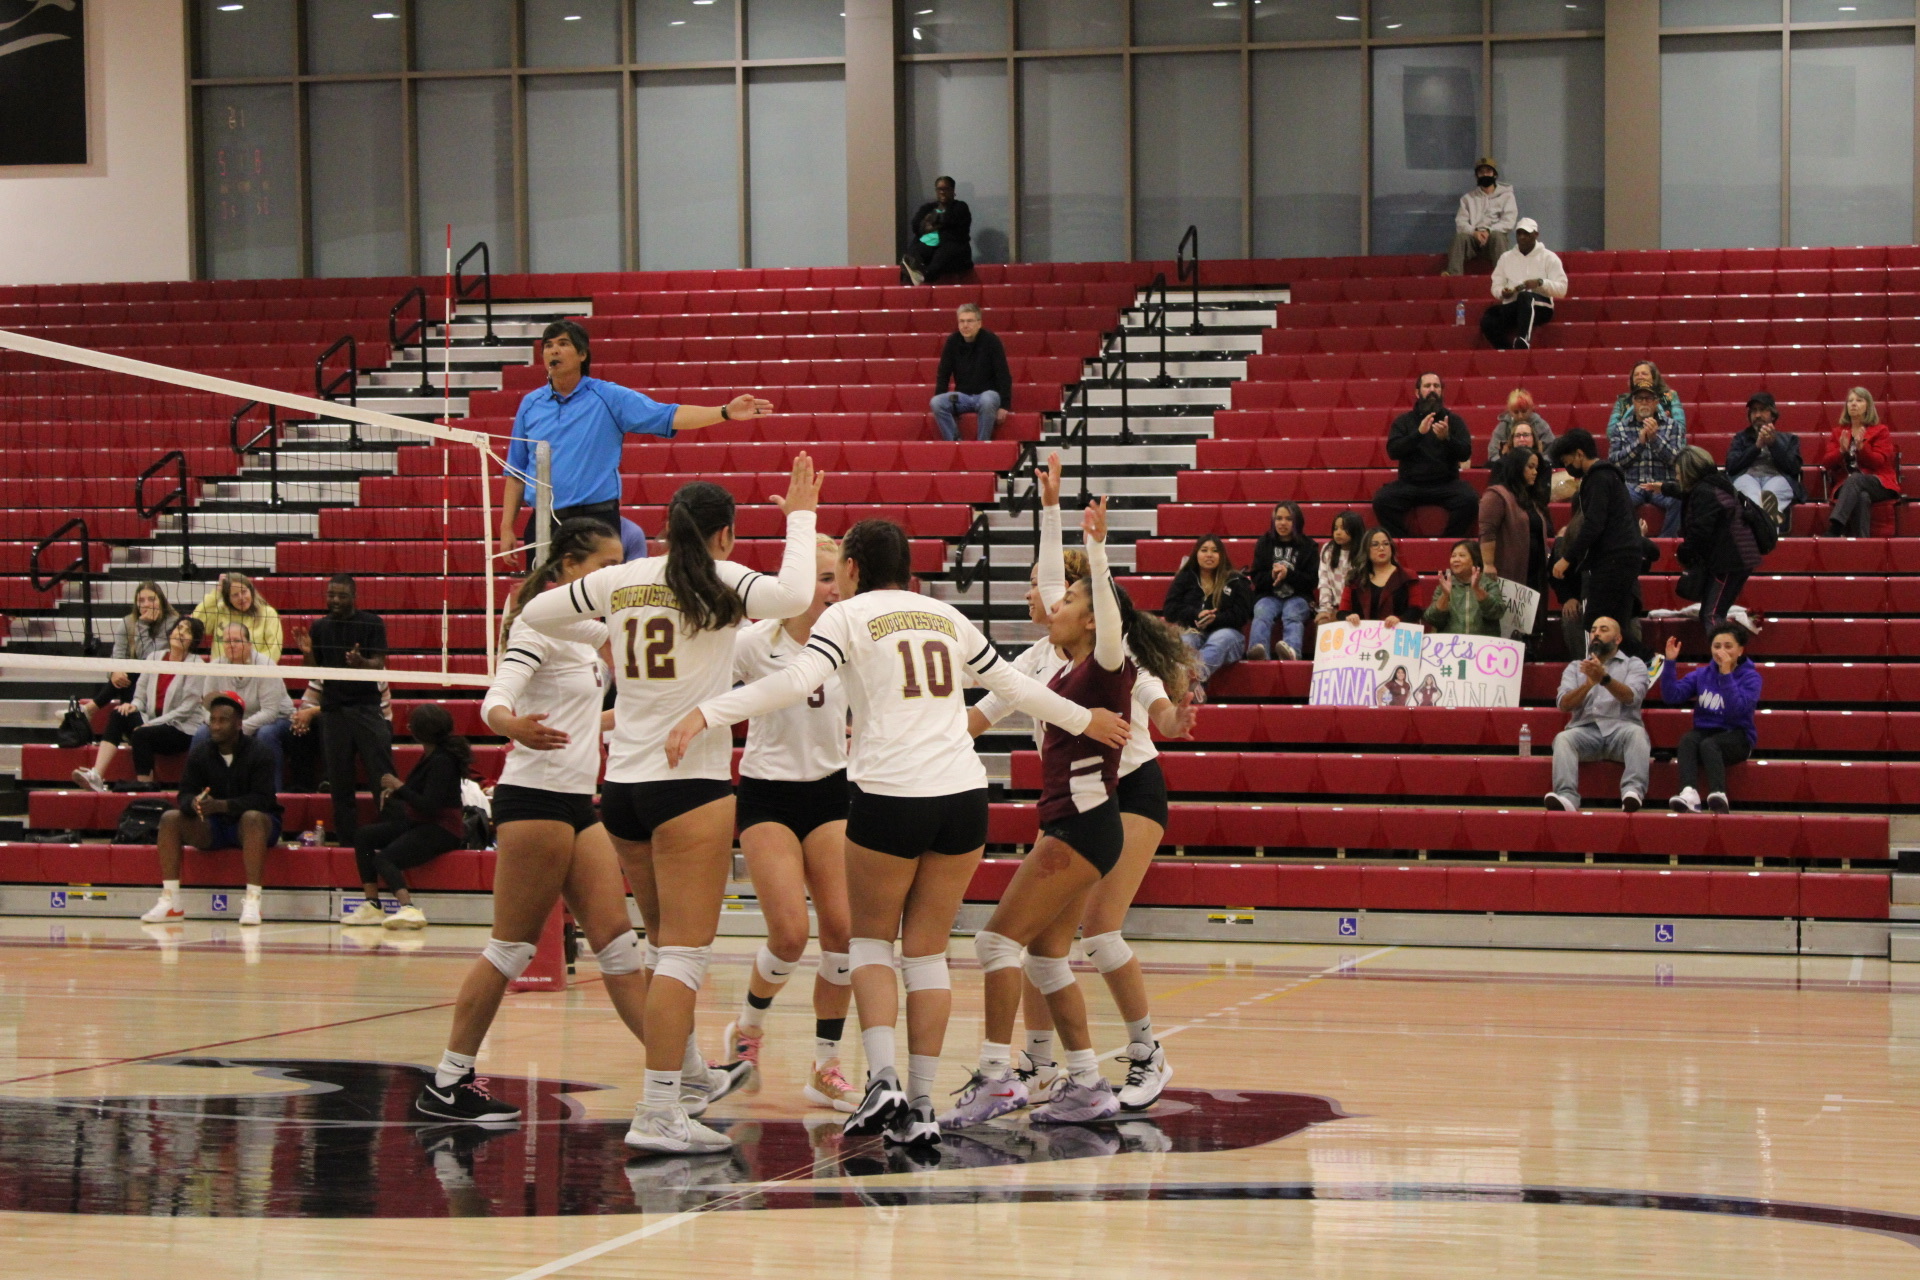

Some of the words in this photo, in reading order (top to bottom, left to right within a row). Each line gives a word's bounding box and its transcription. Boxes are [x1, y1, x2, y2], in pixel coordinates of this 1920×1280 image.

[1514, 583, 1533, 606] YOUR
[867, 610, 958, 642] SOUTHWESTERN
[1319, 627, 1345, 653] GO
[1345, 622, 1391, 655] get
[623, 615, 677, 681] 12
[1421, 635, 1476, 667] Let's
[1476, 644, 1519, 678] GO
[896, 639, 955, 700] 10
[1309, 666, 1377, 705] JENNA
[807, 683, 825, 708] 3
[1442, 681, 1508, 707] ANA
